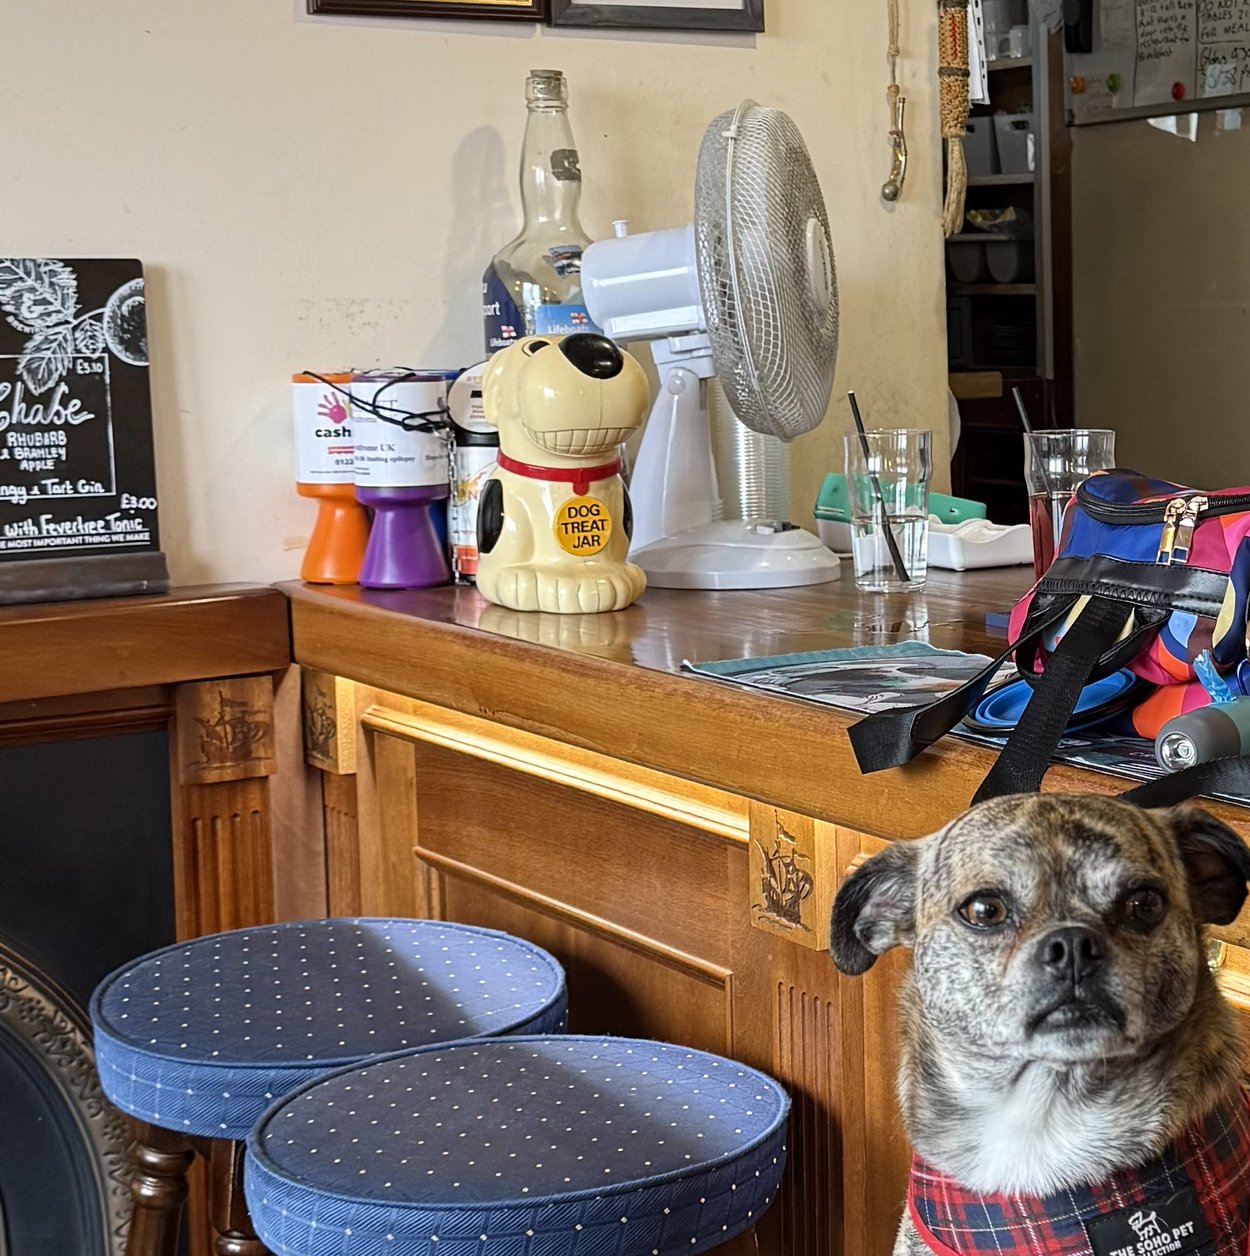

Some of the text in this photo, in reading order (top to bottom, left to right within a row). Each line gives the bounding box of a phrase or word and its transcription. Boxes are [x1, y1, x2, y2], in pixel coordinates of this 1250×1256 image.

[77, 359, 104, 374] £3.10
[6, 430, 67, 447] RHUBARB
[315, 426, 352, 438] cash
[14, 447, 66, 461] BRAMLEY
[19, 459, 55, 472] APPLE
[40, 478, 74, 495] Tart
[77, 479, 105, 493] Gin
[120, 494, 157, 510] £3.00
[568, 504, 600, 518] DOG
[4, 510, 143, 537] with Fevertree Tonic
[561, 519, 608, 535] TREAT
[8, 539, 33, 548] MOST
[33, 536, 84, 547] IMPORTANT
[84, 534, 110, 544] THING
[111, 533, 126, 542] WE
[125, 531, 150, 541] MAKE
[573, 535, 601, 548] JAR
[1136, 1233, 1171, 1254] SOHO
[1172, 1221, 1194, 1240] PET
